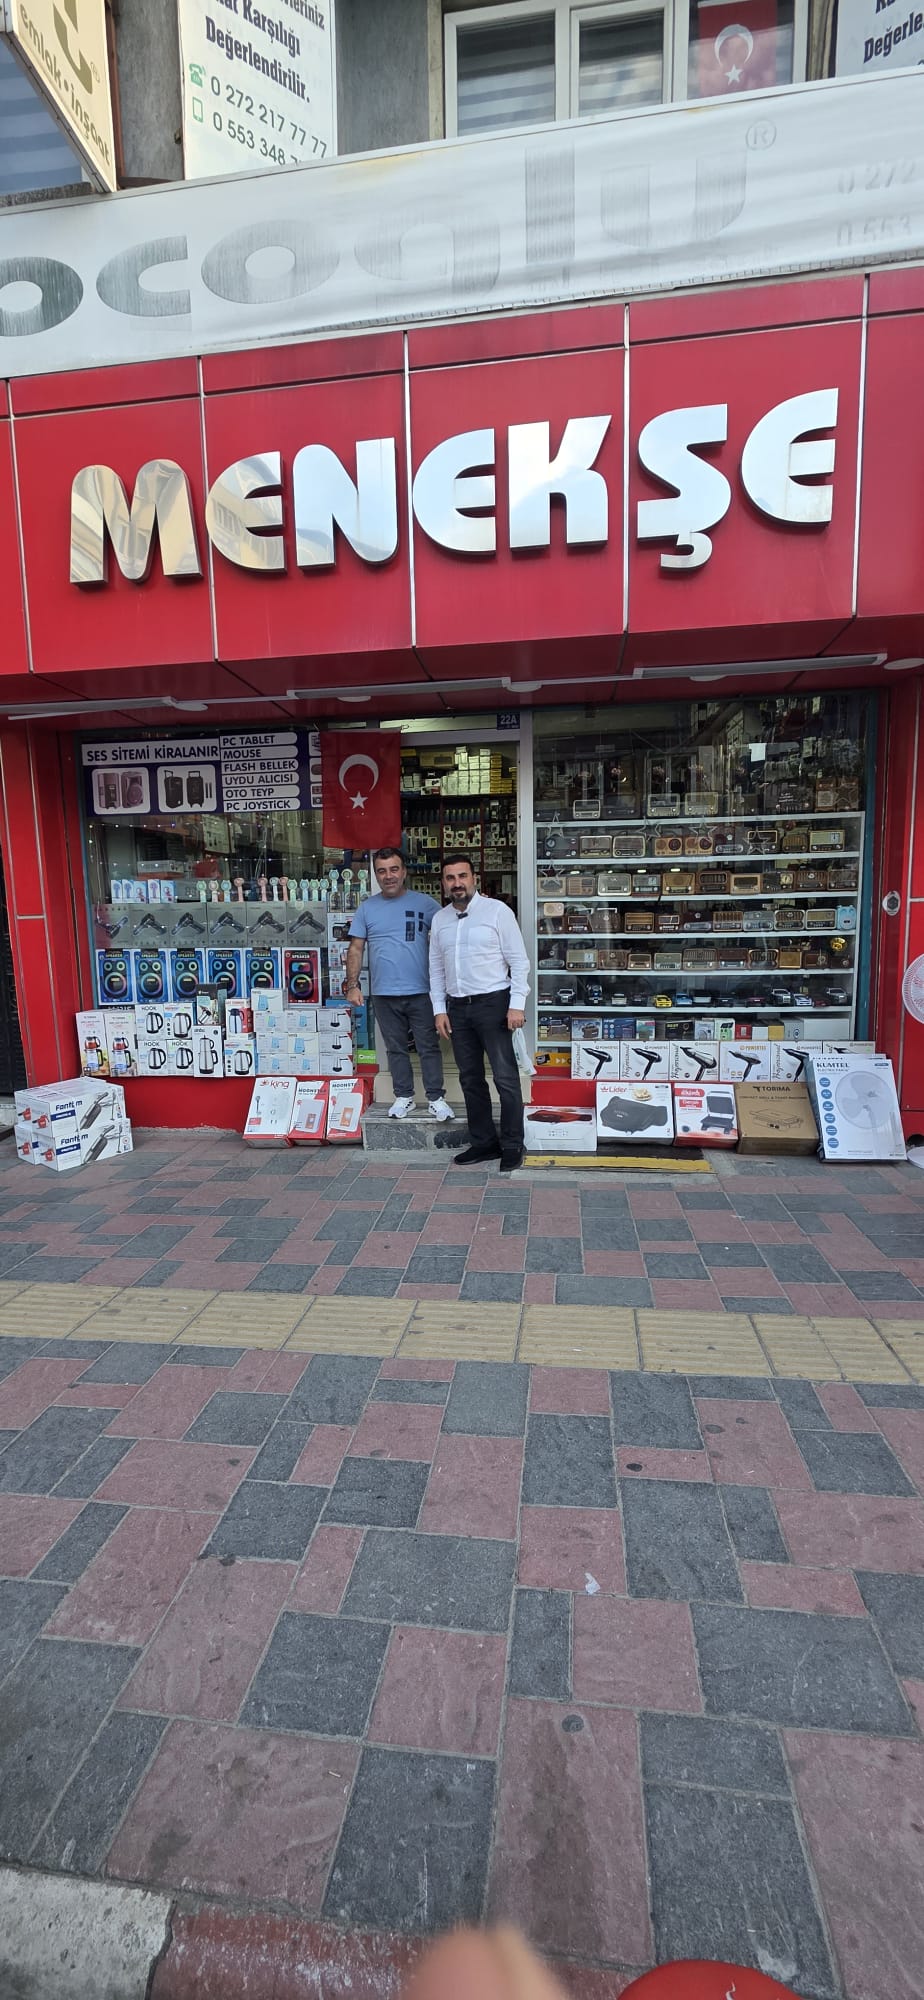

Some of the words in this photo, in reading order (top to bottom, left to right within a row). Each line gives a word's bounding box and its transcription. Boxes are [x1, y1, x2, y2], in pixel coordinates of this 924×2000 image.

[242, 0, 301, 58] Karşılığı
[863, 11, 924, 64] Değerle
[205, 15, 310, 103] Değerlendirilir.
[20, 3, 61, 88] emlak
[71, 83, 110, 166] inşaat
[211, 76, 221, 96] 0
[225, 84, 255, 116] 272
[258, 103, 285, 132] 217
[290, 122, 306, 146] 77
[311, 135, 327, 158] 77
[212, 111, 222, 132] 0
[227, 119, 255, 149] 553
[259, 137, 286, 165] 348
[69, 387, 838, 585] MENEKŞE
[500, 714, 517, 725] 22A
[222, 736, 238, 746] PC
[239, 734, 275, 745] TABLET
[87, 750, 108, 762] SES
[111, 746, 150, 761] SİTEMİ
[154, 744, 218, 759] KİRALANIR
[223, 749, 262, 759] MOUSE
[224, 761, 256, 772] FLASH
[259, 760, 296, 770] BELLEK
[224, 775, 254, 786] UYDU
[257, 773, 294, 784] ALICISI
[225, 788, 247, 798] OTO
[249, 787, 275, 797] TEYP
[225, 801, 240, 811] PC
[270, 1080, 290, 1090] king
